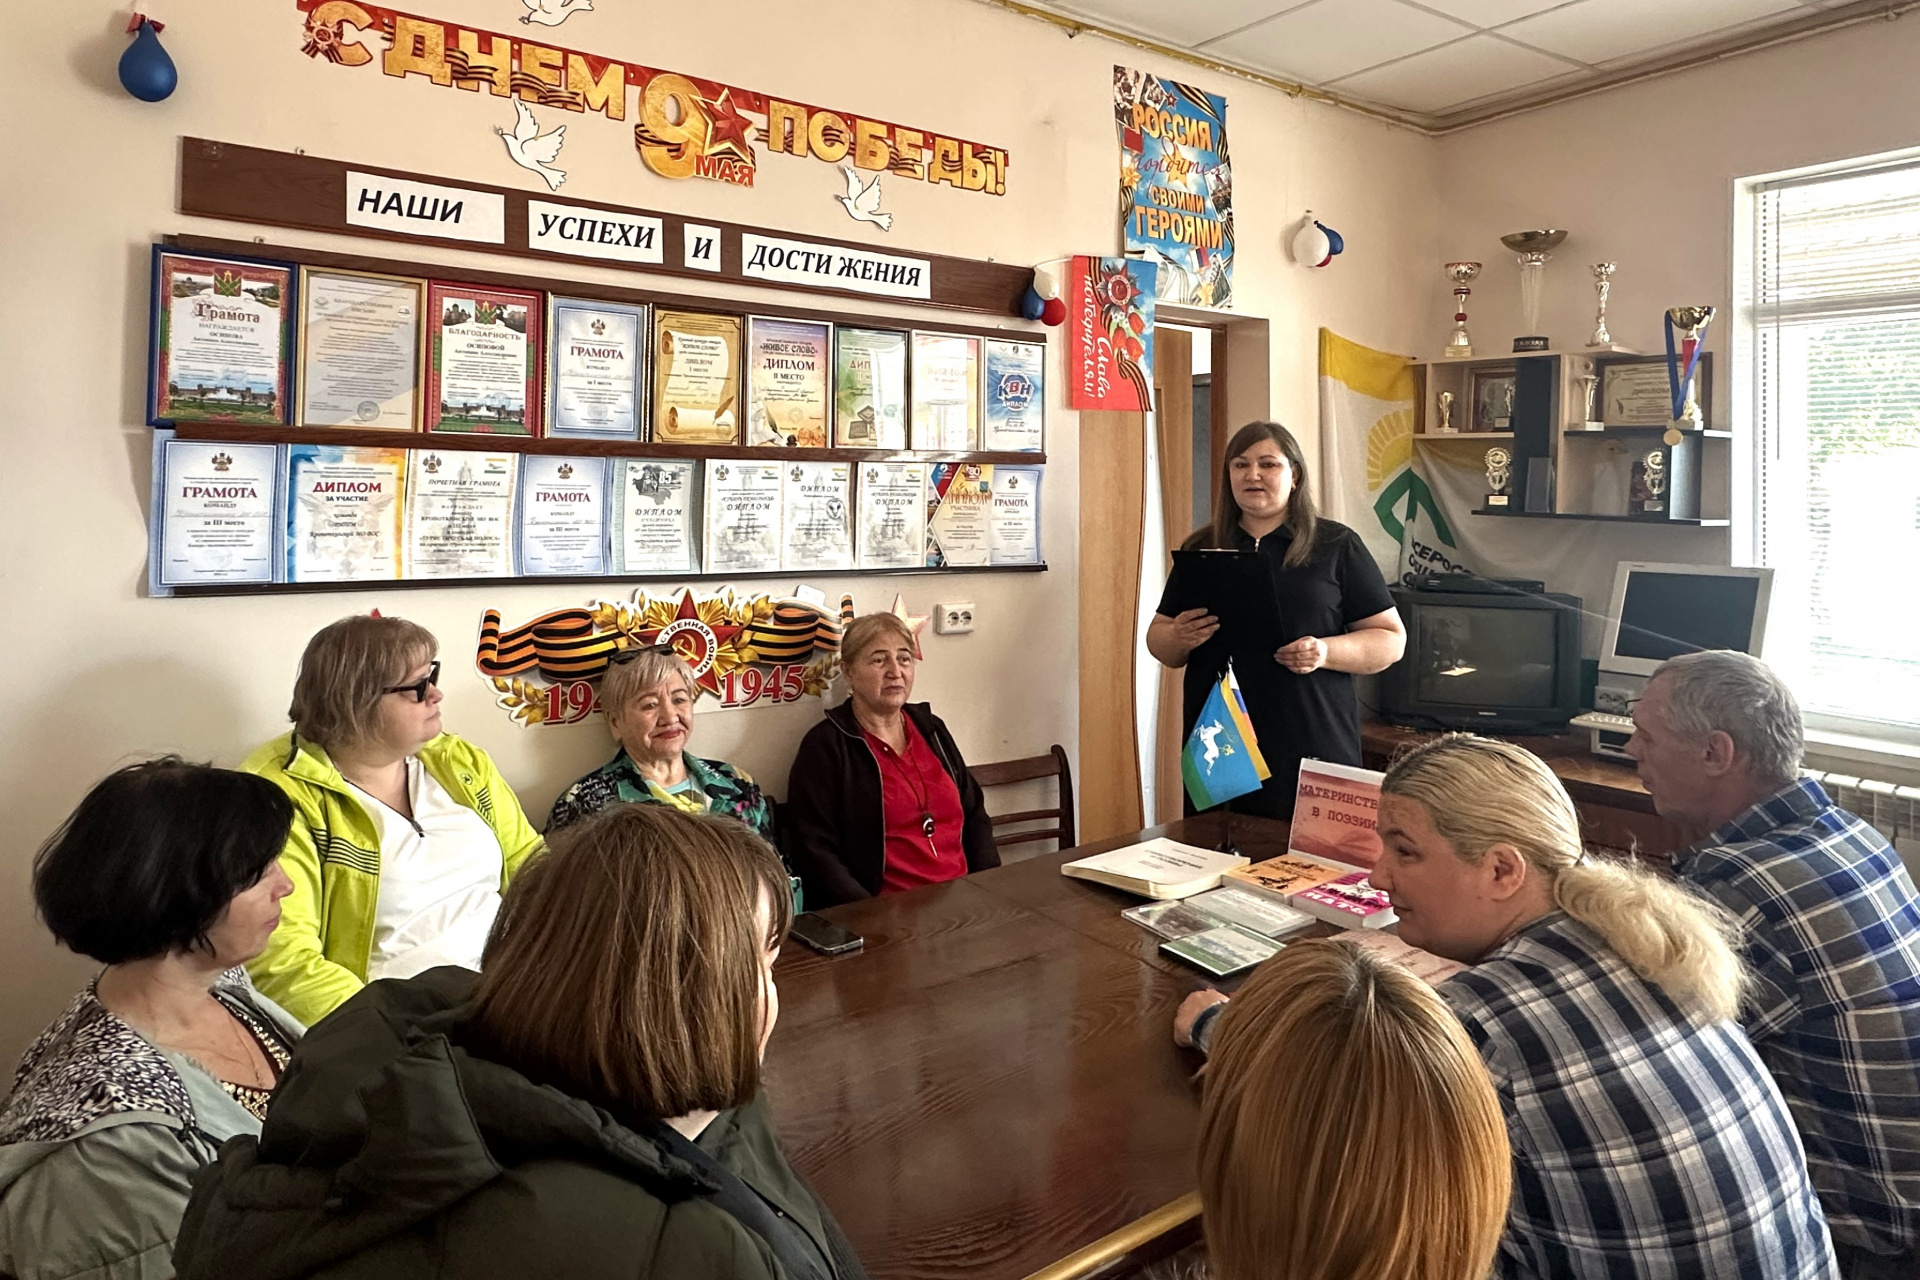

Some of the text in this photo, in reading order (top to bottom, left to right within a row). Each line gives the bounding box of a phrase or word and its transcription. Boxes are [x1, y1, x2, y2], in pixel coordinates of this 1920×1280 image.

[305, 1, 706, 179] С ДНЕМ 9
[1132, 102, 1213, 152] РОССИЯ
[769, 100, 1006, 195] ПОБЕДЫ!
[695, 155, 754, 187] МАЯ
[358, 189, 463, 223] НАШИ
[1151, 185, 1205, 215] СВОИМИ
[537, 213, 655, 249] УСПЕХИ
[1134, 205, 1224, 250] ГЕРОЯМИ
[692, 237, 713, 260] И
[193, 302, 260, 323] Грамота
[448, 327, 522, 341] БЛАГОДАРНОСТЬ
[570, 345, 624, 360] ГРАМОТА
[763, 358, 815, 372] ДИПЛОМ
[849, 360, 871, 370] ДИП
[1097, 336, 1112, 398] Слава
[780, 373, 805, 381] МЕСТО
[998, 381, 1031, 397] КВН
[312, 481, 382, 493] ДИПЛОМ
[659, 470, 672, 484] 85
[182, 486, 257, 499] ГРАМОТА
[535, 491, 591, 502] ГРАМОТА
[994, 498, 1029, 508] ГРАМОТА
[718, 664, 805, 708] 1945
[543, 681, 602, 725] 19
[1312, 806, 1377, 830] В ПОЭЗИИ
